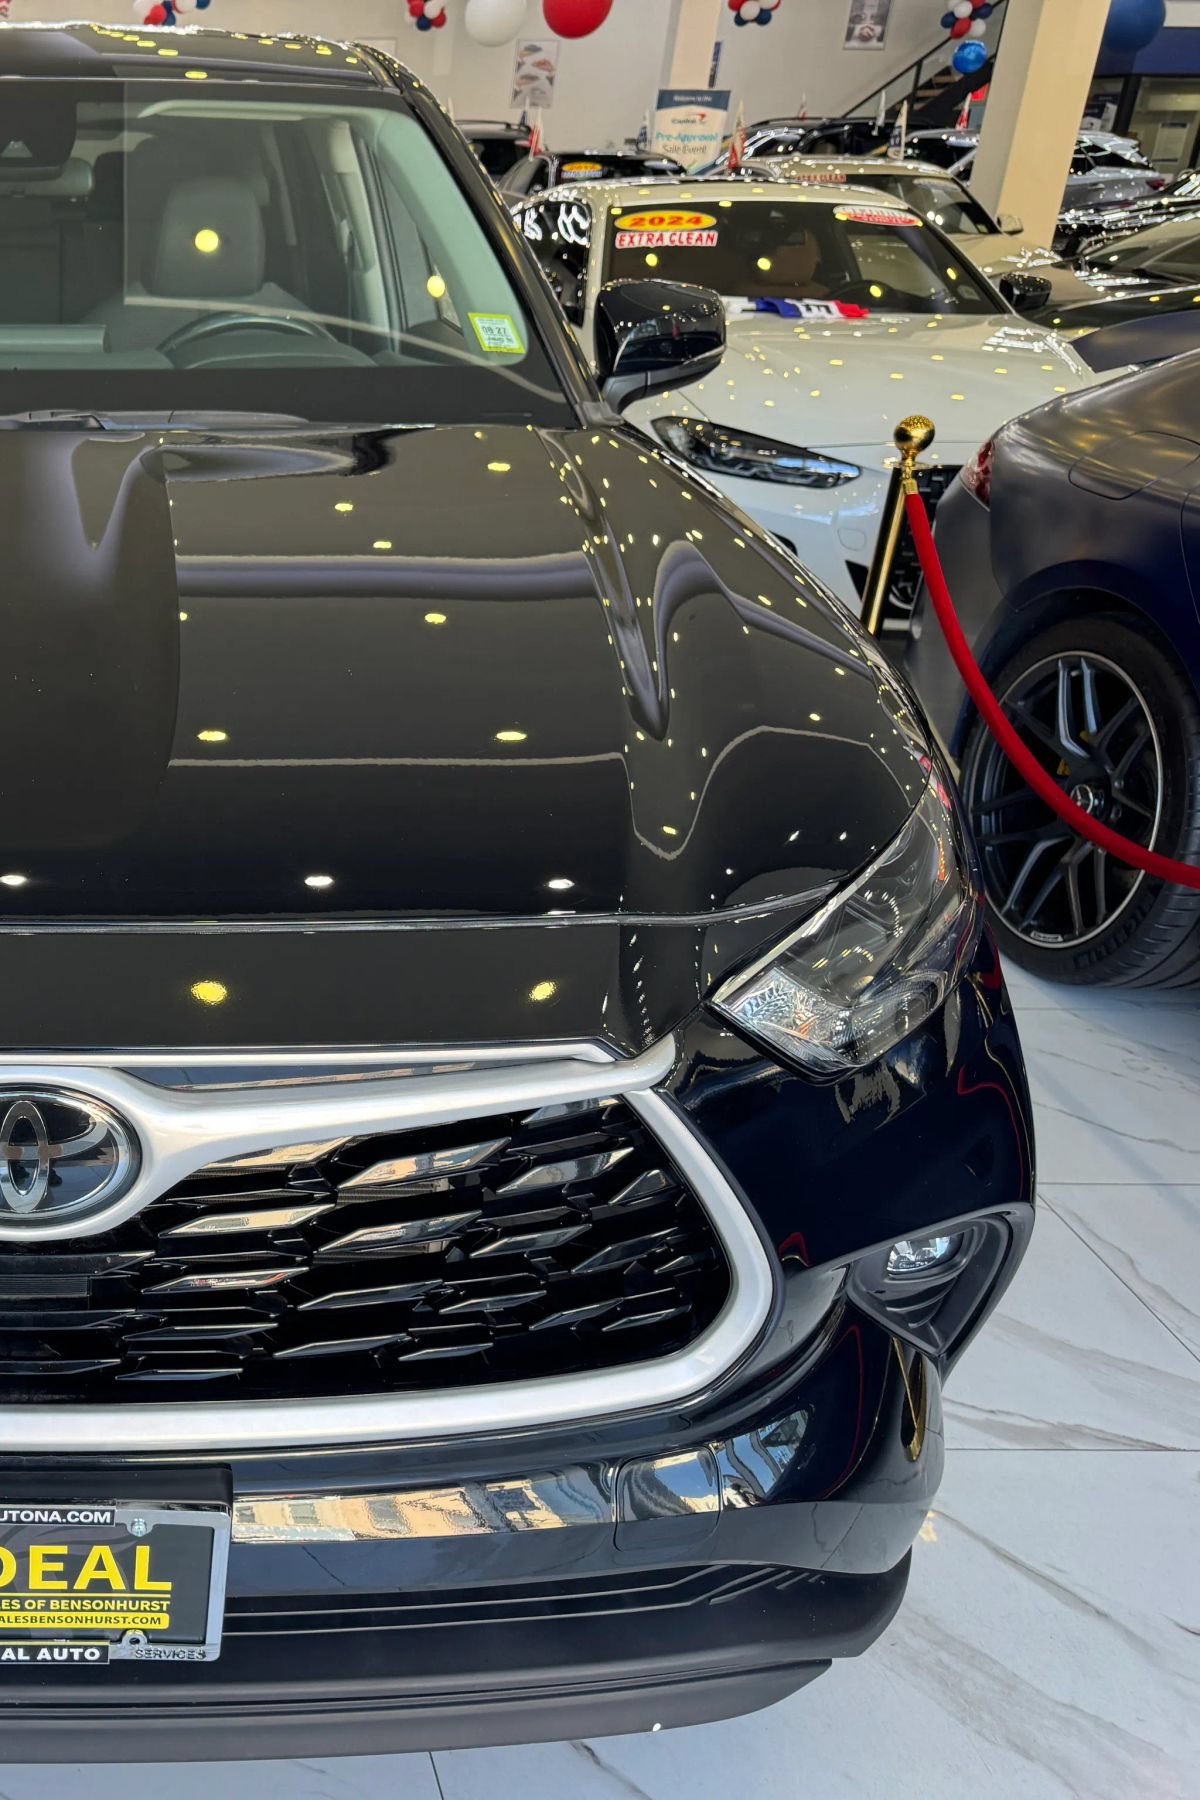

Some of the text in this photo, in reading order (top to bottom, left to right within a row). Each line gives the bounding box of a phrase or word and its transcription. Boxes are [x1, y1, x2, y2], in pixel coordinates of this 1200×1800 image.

[629, 215, 704, 228] 2024
[618, 232, 715, 247] EXTRA CLEAN
[24, 1599, 46, 1610] OF
[50, 1599, 171, 1611] BENSONHURST
[36, 1647, 100, 1661] AUTO
[135, 1648, 207, 1661] SERVICES
